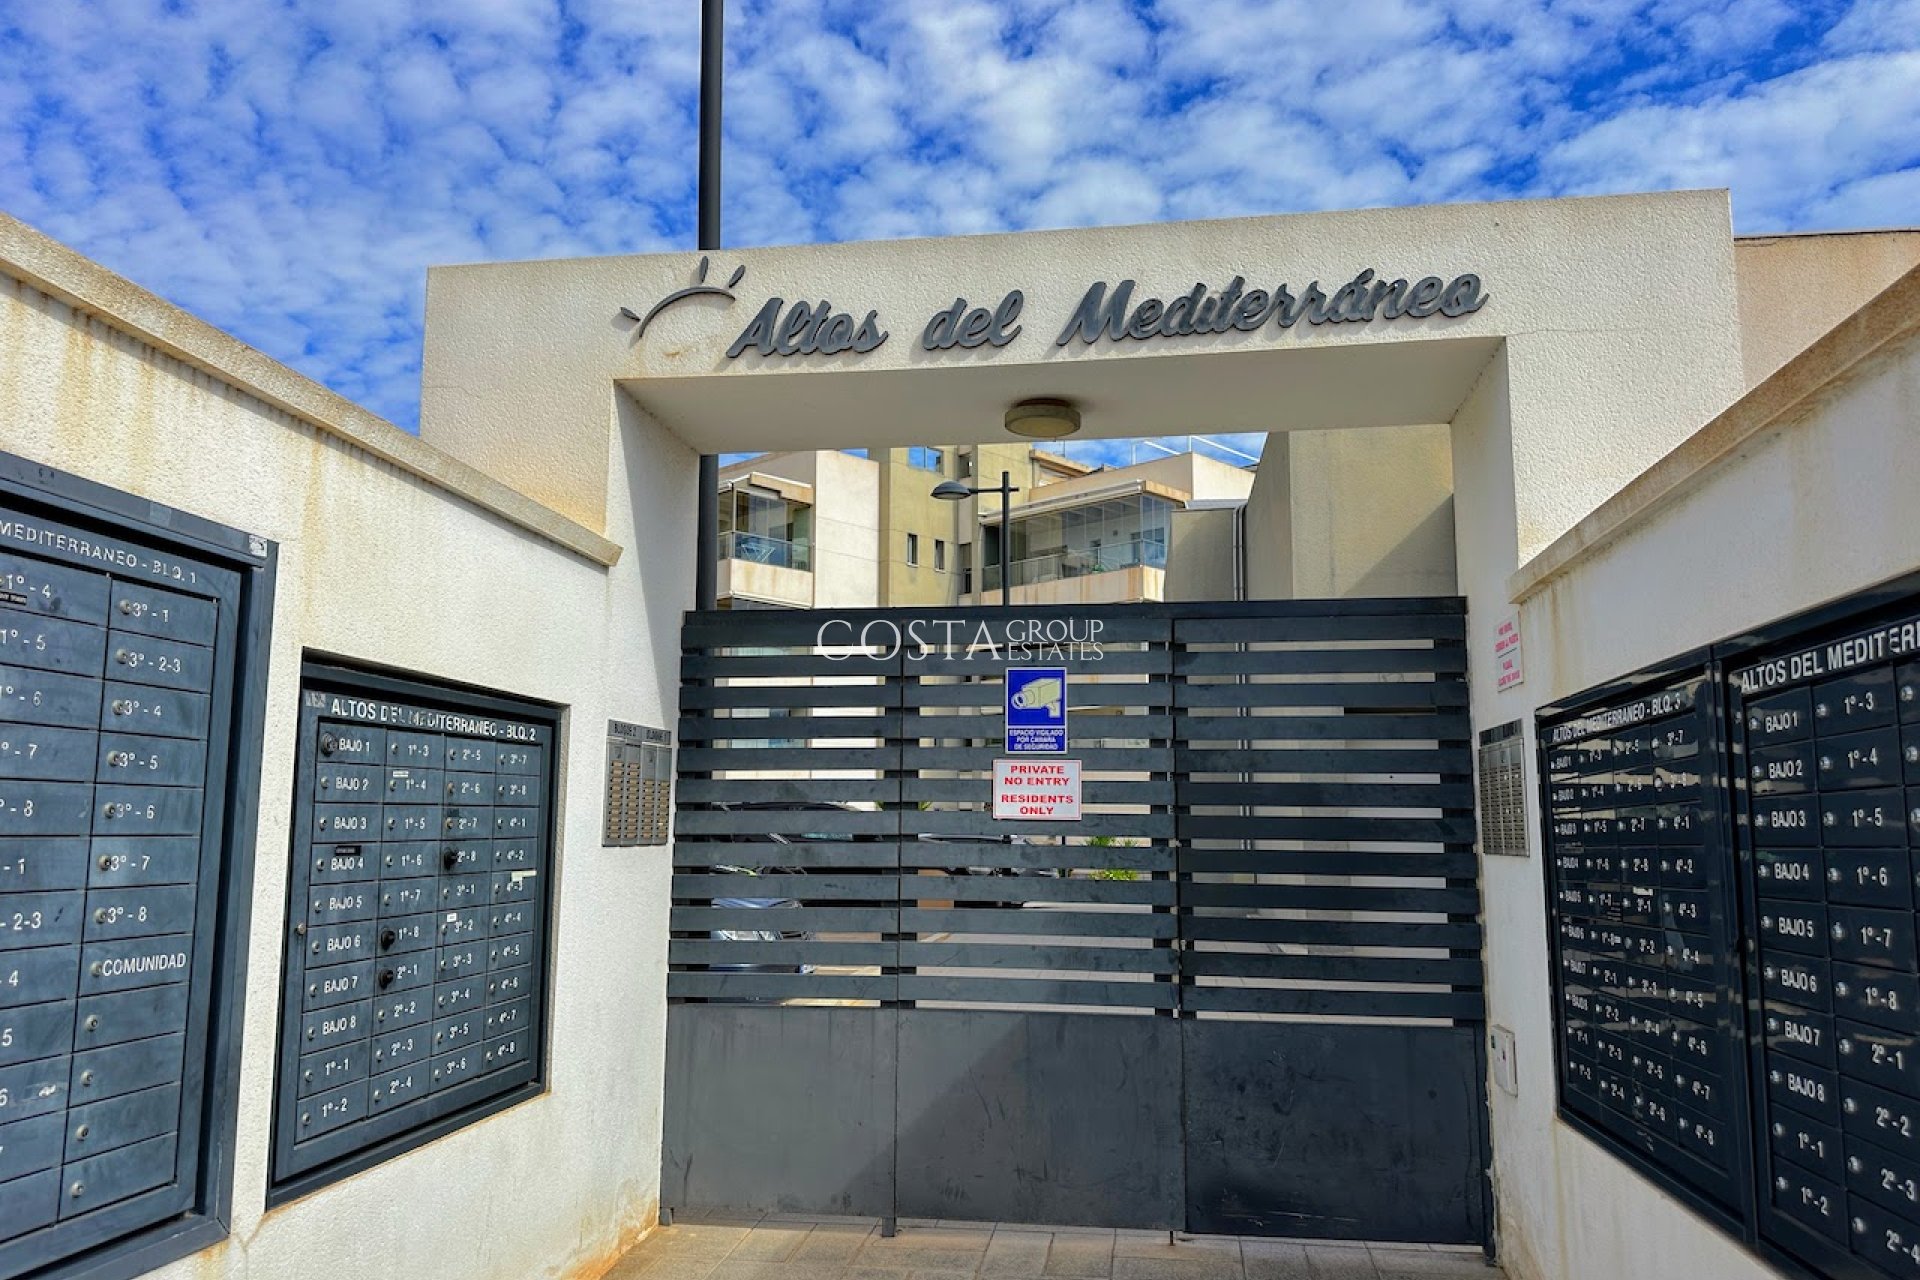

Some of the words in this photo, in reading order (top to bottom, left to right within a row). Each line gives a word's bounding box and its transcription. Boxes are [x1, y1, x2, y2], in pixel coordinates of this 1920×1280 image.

[726, 297, 888, 360] Altos
[922, 288, 1023, 351] del
[1056, 266, 1491, 346] Mediterráneo
[1741, 659, 1786, 694] ALTOS
[1790, 651, 1823, 680] DEL
[331, 698, 376, 721] ALTOS
[529, 728, 536, 741] 2
[1766, 714, 1790, 733] BAJO
[1792, 711, 1798, 727] 1
[339, 737, 364, 752] BAJO
[365, 741, 370, 752] 1
[1010, 765, 1065, 774] PRIVATE
[1769, 761, 1795, 779] BAJO
[1796, 759, 1803, 776] 2
[335, 778, 360, 791] BAJO
[362, 779, 369, 791] 2
[1004, 777, 1023, 786] NO
[1027, 777, 1070, 786] ENTRY
[1001, 794, 1074, 804] RESIDENTS
[1019, 806, 1054, 815] ONLY
[1771, 810, 1796, 828] BAJO
[1799, 810, 1806, 827] 3
[334, 816, 358, 830] BAJO
[360, 816, 367, 829] 3
[331, 857, 355, 871] BAJO
[356, 857, 364, 869] 4
[1774, 863, 1800, 880] BAJO
[1802, 863, 1809, 881] 4
[329, 897, 354, 910] BAJO
[356, 896, 362, 909] 5
[1778, 916, 1804, 936] BAJO
[1807, 920, 1814, 938] 5
[327, 936, 352, 950] BAJO
[354, 934, 361, 948] 6
[102, 953, 187, 978] COMUNIDAD
[323, 979, 349, 994] BAJO
[351, 975, 358, 989] 7
[1781, 968, 1808, 991] BAJO
[1810, 975, 1817, 993] 6
[322, 1020, 348, 1035] BAJO
[350, 1017, 357, 1030] 8
[1784, 1020, 1812, 1045] BAJO
[1813, 1029, 1821, 1047] 7
[1787, 1072, 1815, 1099] BAJO
[1818, 1083, 1825, 1103] 8
